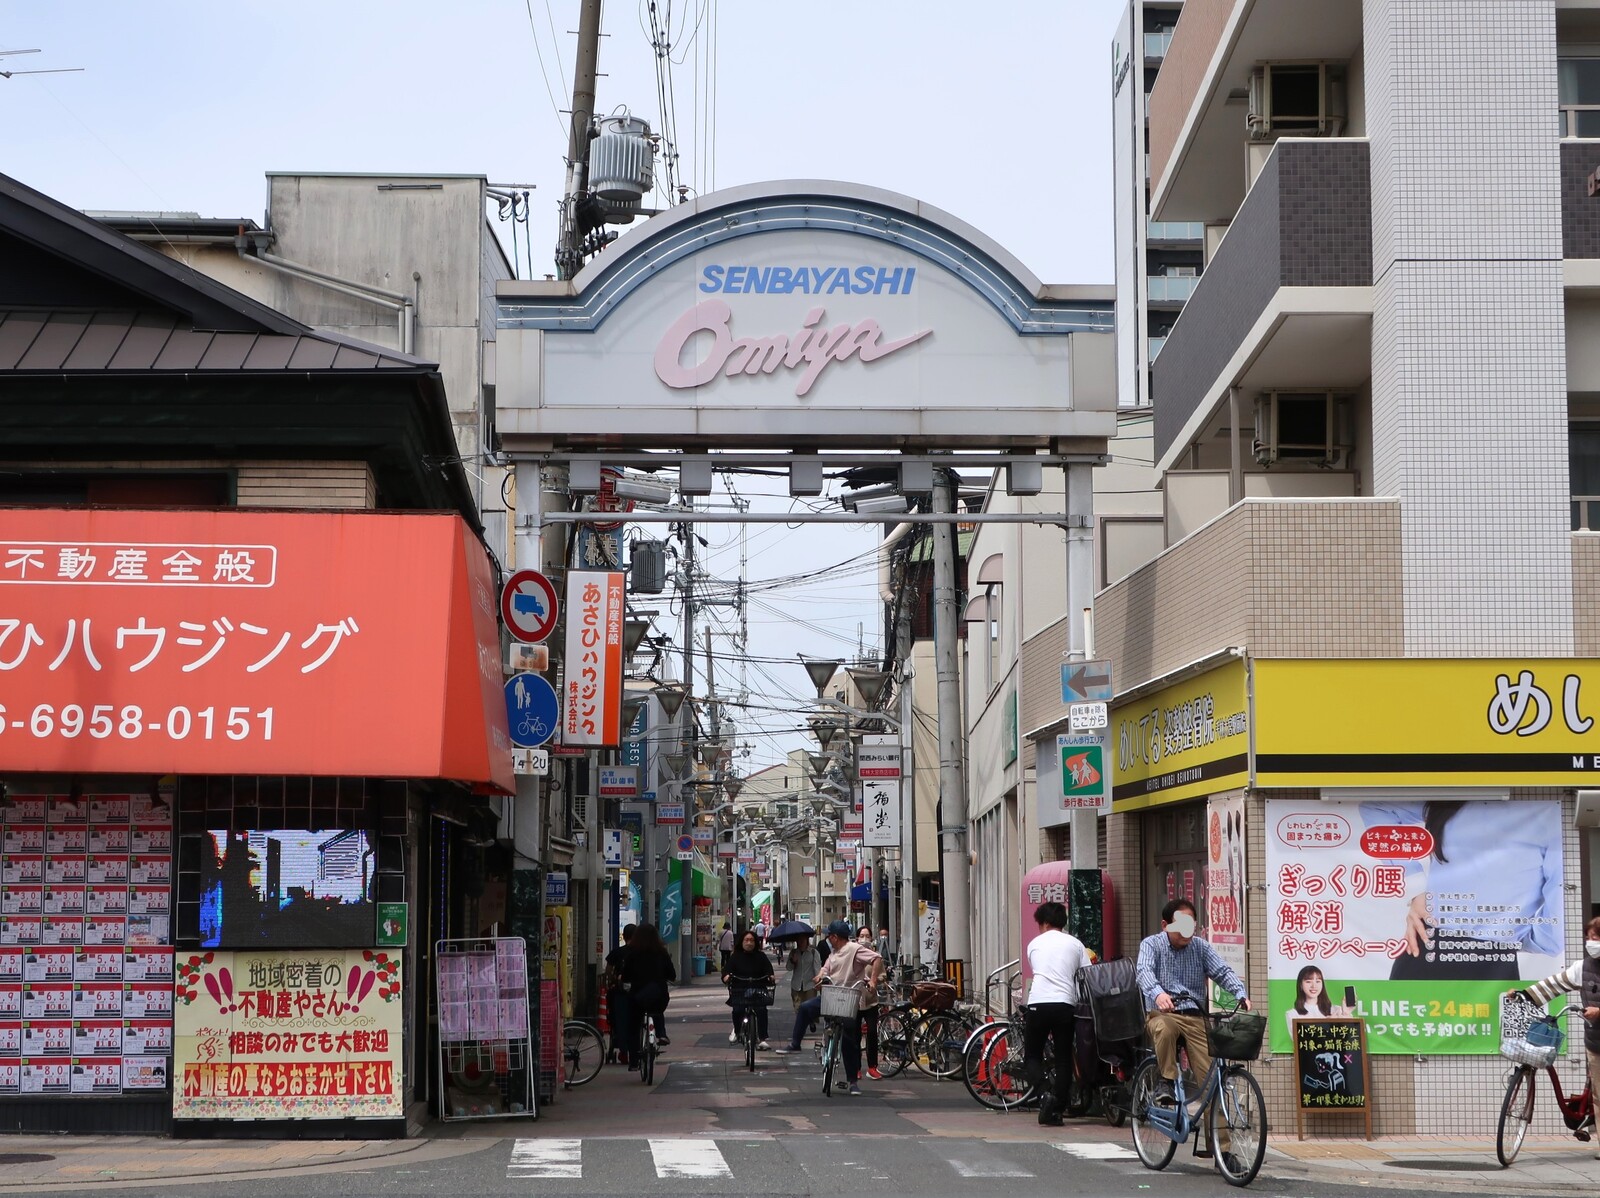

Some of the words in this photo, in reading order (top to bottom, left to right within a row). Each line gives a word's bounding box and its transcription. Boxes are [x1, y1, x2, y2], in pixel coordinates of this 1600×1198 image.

[699, 264, 916, 294] SENBAYASHI
[653, 300, 932, 396] Omiya
[5, 548, 256, 582] 不動産全般
[607, 586, 619, 645] 不動産全般
[580, 582, 601, 736] あさひハウジング
[0, 704, 275, 740] -6958-0151
[567, 681, 577, 734] 株式会社
[1071, 705, 1106, 715] 自転車を除く
[1072, 715, 1106, 728] ここから
[1058, 735, 1104, 745] あんしん歩行エリア
[1063, 797, 1105, 808] 歩行者に注意!
[1286, 831, 1342, 842] 固まった痛み
[1367, 842, 1423, 853] 突然の痛み
[1277, 863, 1406, 898] ぎっくり腰
[662, 890, 679, 938] くすり
[1277, 901, 1344, 934] 解消
[1278, 937, 1409, 961] キャンペーン
[249, 963, 342, 989] 地域密着の
[238, 989, 345, 1019] 不動産やさん
[228, 1030, 389, 1055] 相談のみでも大歓迎
[185, 1063, 392, 1096] 不動産の事ならおまかせ下さい
